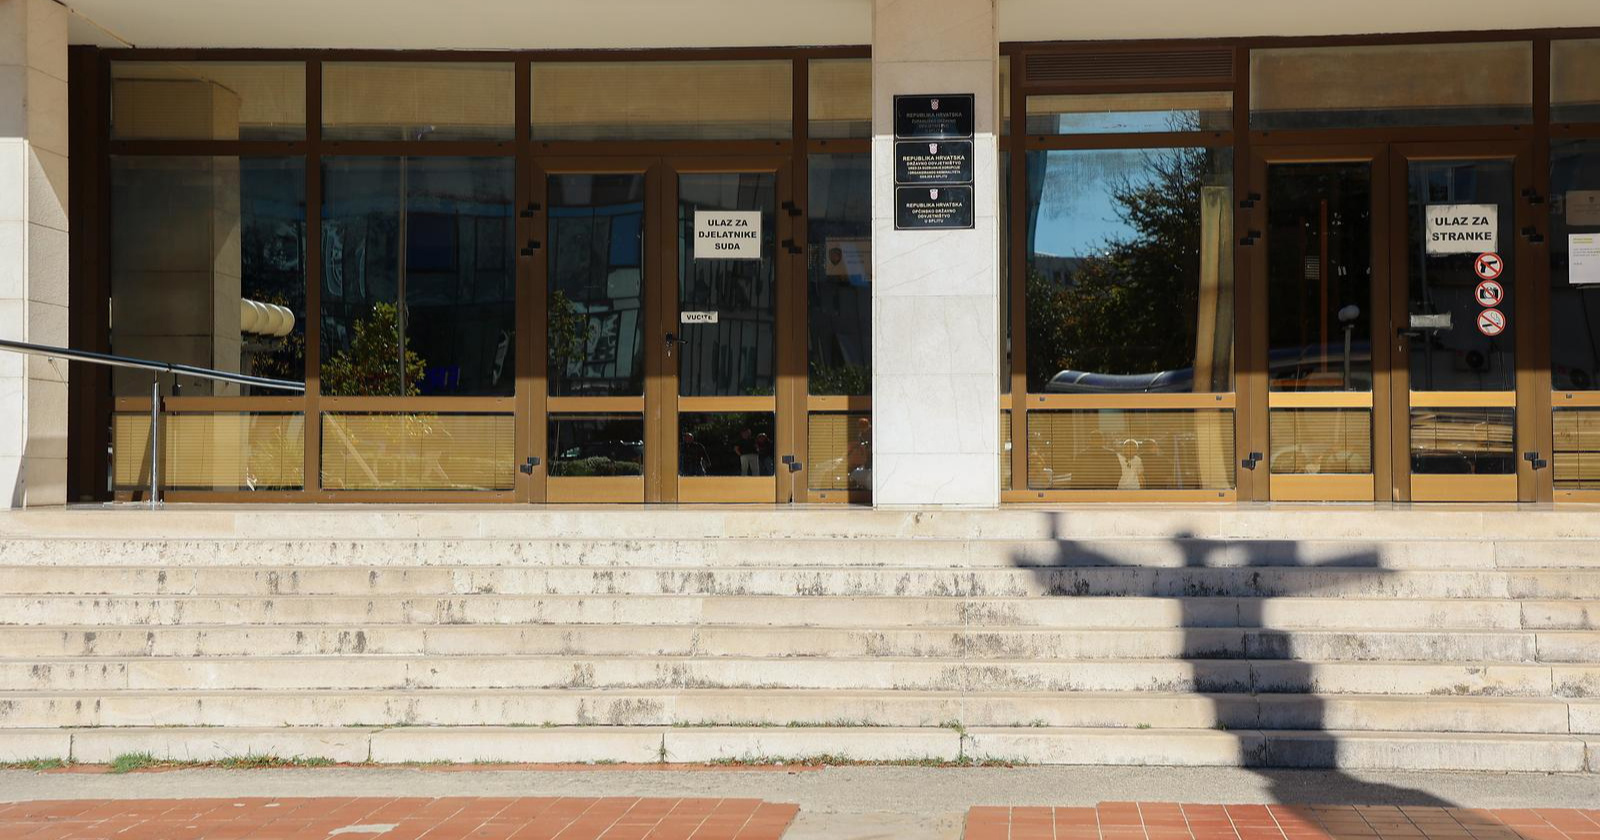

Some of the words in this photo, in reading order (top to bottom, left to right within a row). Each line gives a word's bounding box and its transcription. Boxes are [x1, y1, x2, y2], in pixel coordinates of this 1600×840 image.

[1435, 217, 1468, 226] ULAZ
[1472, 217, 1489, 226] ZA
[1432, 232, 1492, 241] STRANKE
